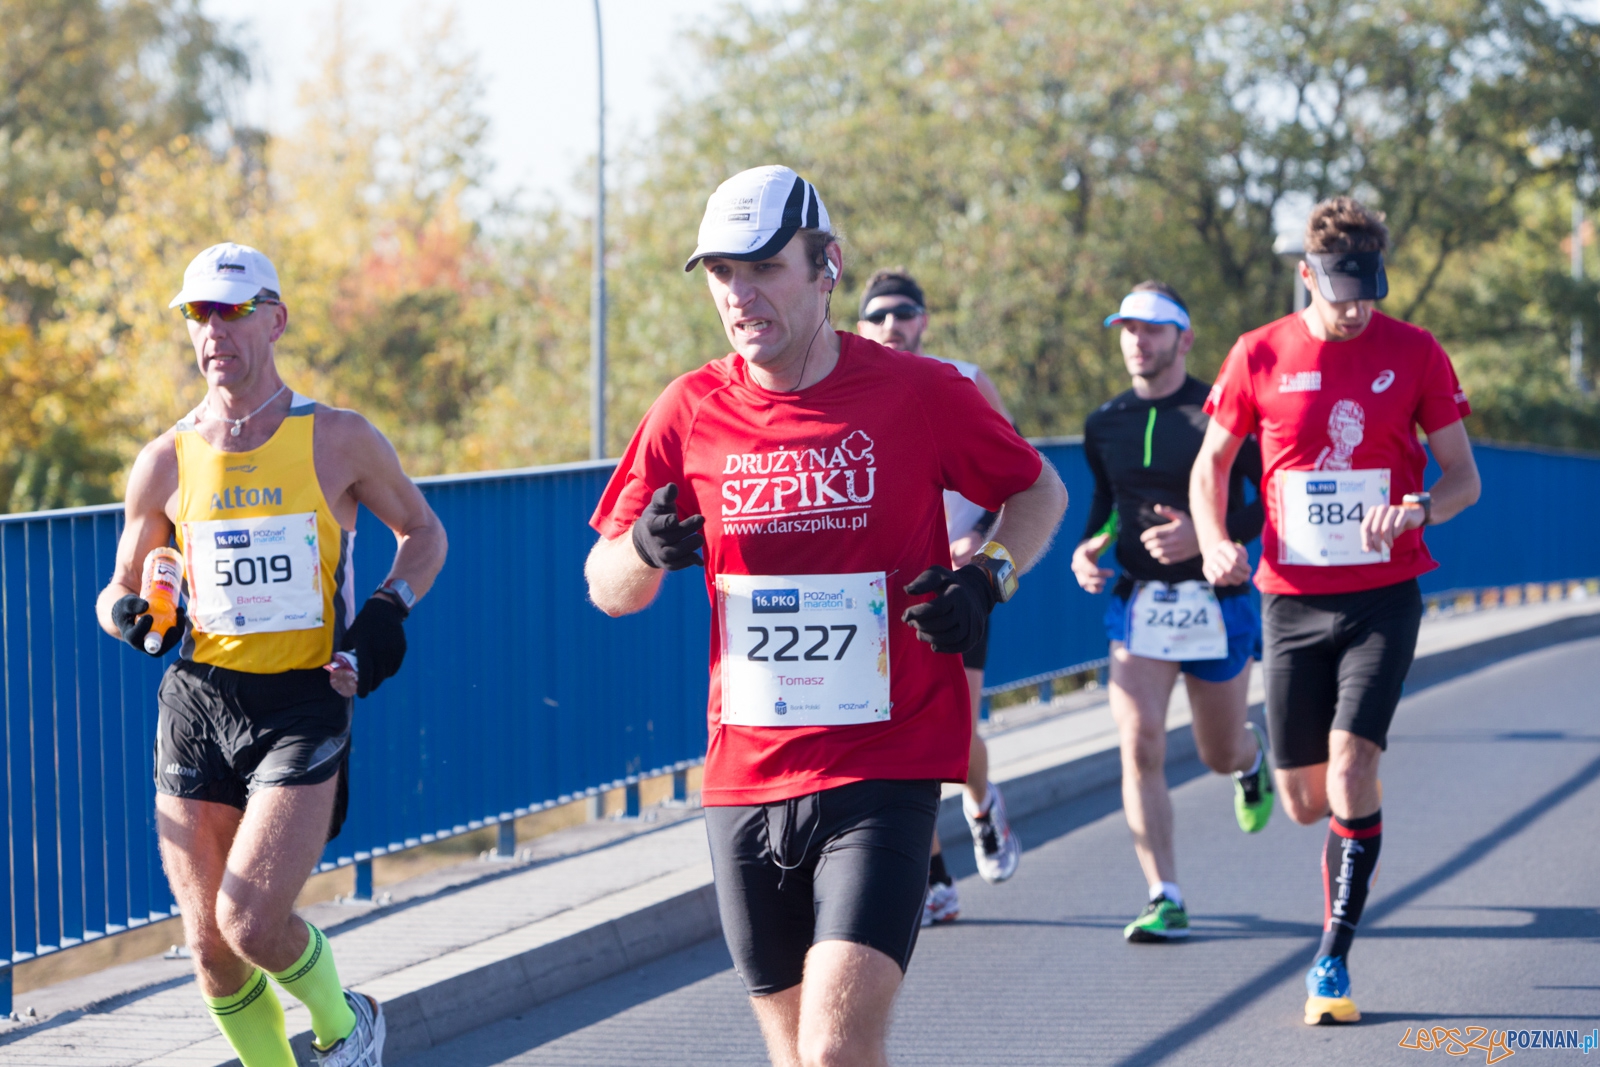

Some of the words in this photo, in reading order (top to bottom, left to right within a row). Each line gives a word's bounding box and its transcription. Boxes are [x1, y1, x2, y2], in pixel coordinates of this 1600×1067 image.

[722, 445, 848, 474] DRUŻYNA
[722, 467, 876, 516] SZPIKU
[722, 513, 868, 536] www.darszpiku.pl
[1308, 503, 1364, 525] 884
[215, 554, 292, 587] 5019
[236, 595, 272, 605] Bartosz
[803, 600, 844, 608] maraton
[1146, 607, 1208, 629] 2424
[747, 624, 858, 661] 2227
[777, 675, 825, 686] Tomasz
